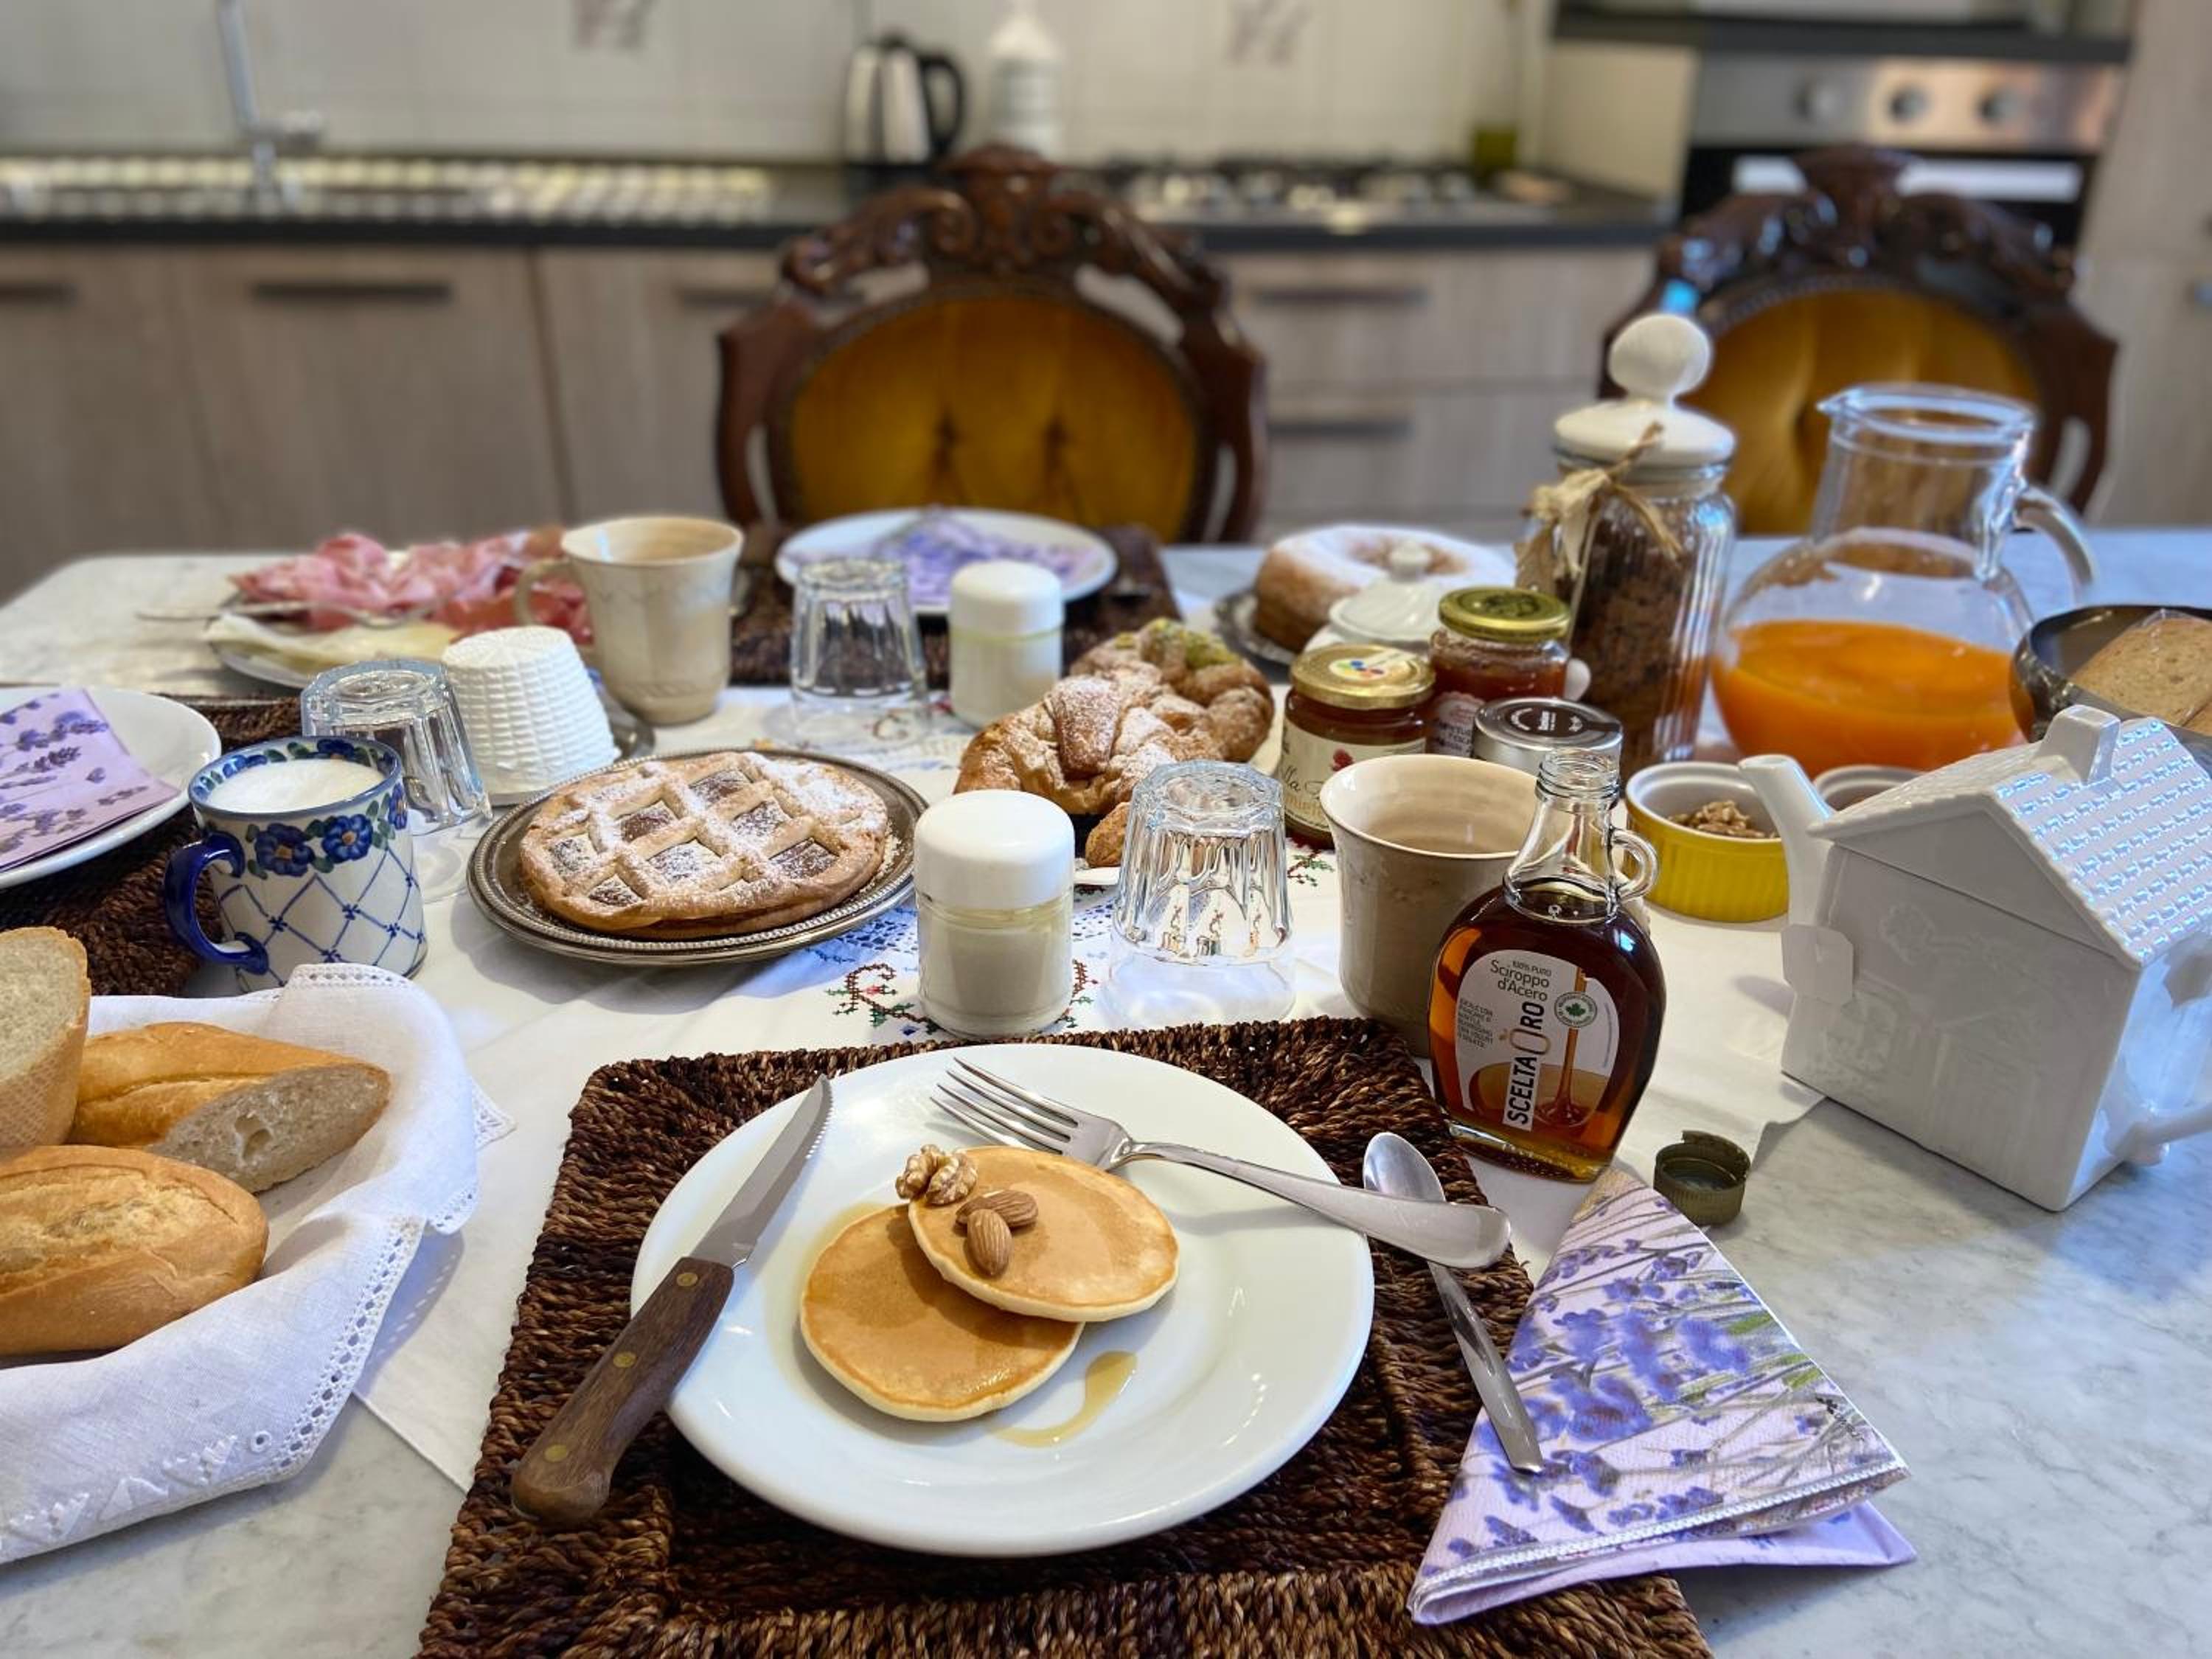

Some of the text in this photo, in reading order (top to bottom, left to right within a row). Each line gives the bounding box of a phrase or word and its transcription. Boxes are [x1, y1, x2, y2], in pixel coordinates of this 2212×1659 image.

[1490, 959, 1550, 989] Sciroppo
[1532, 966, 1551, 977] PURO
[1498, 977, 1548, 1001] d'Acero
